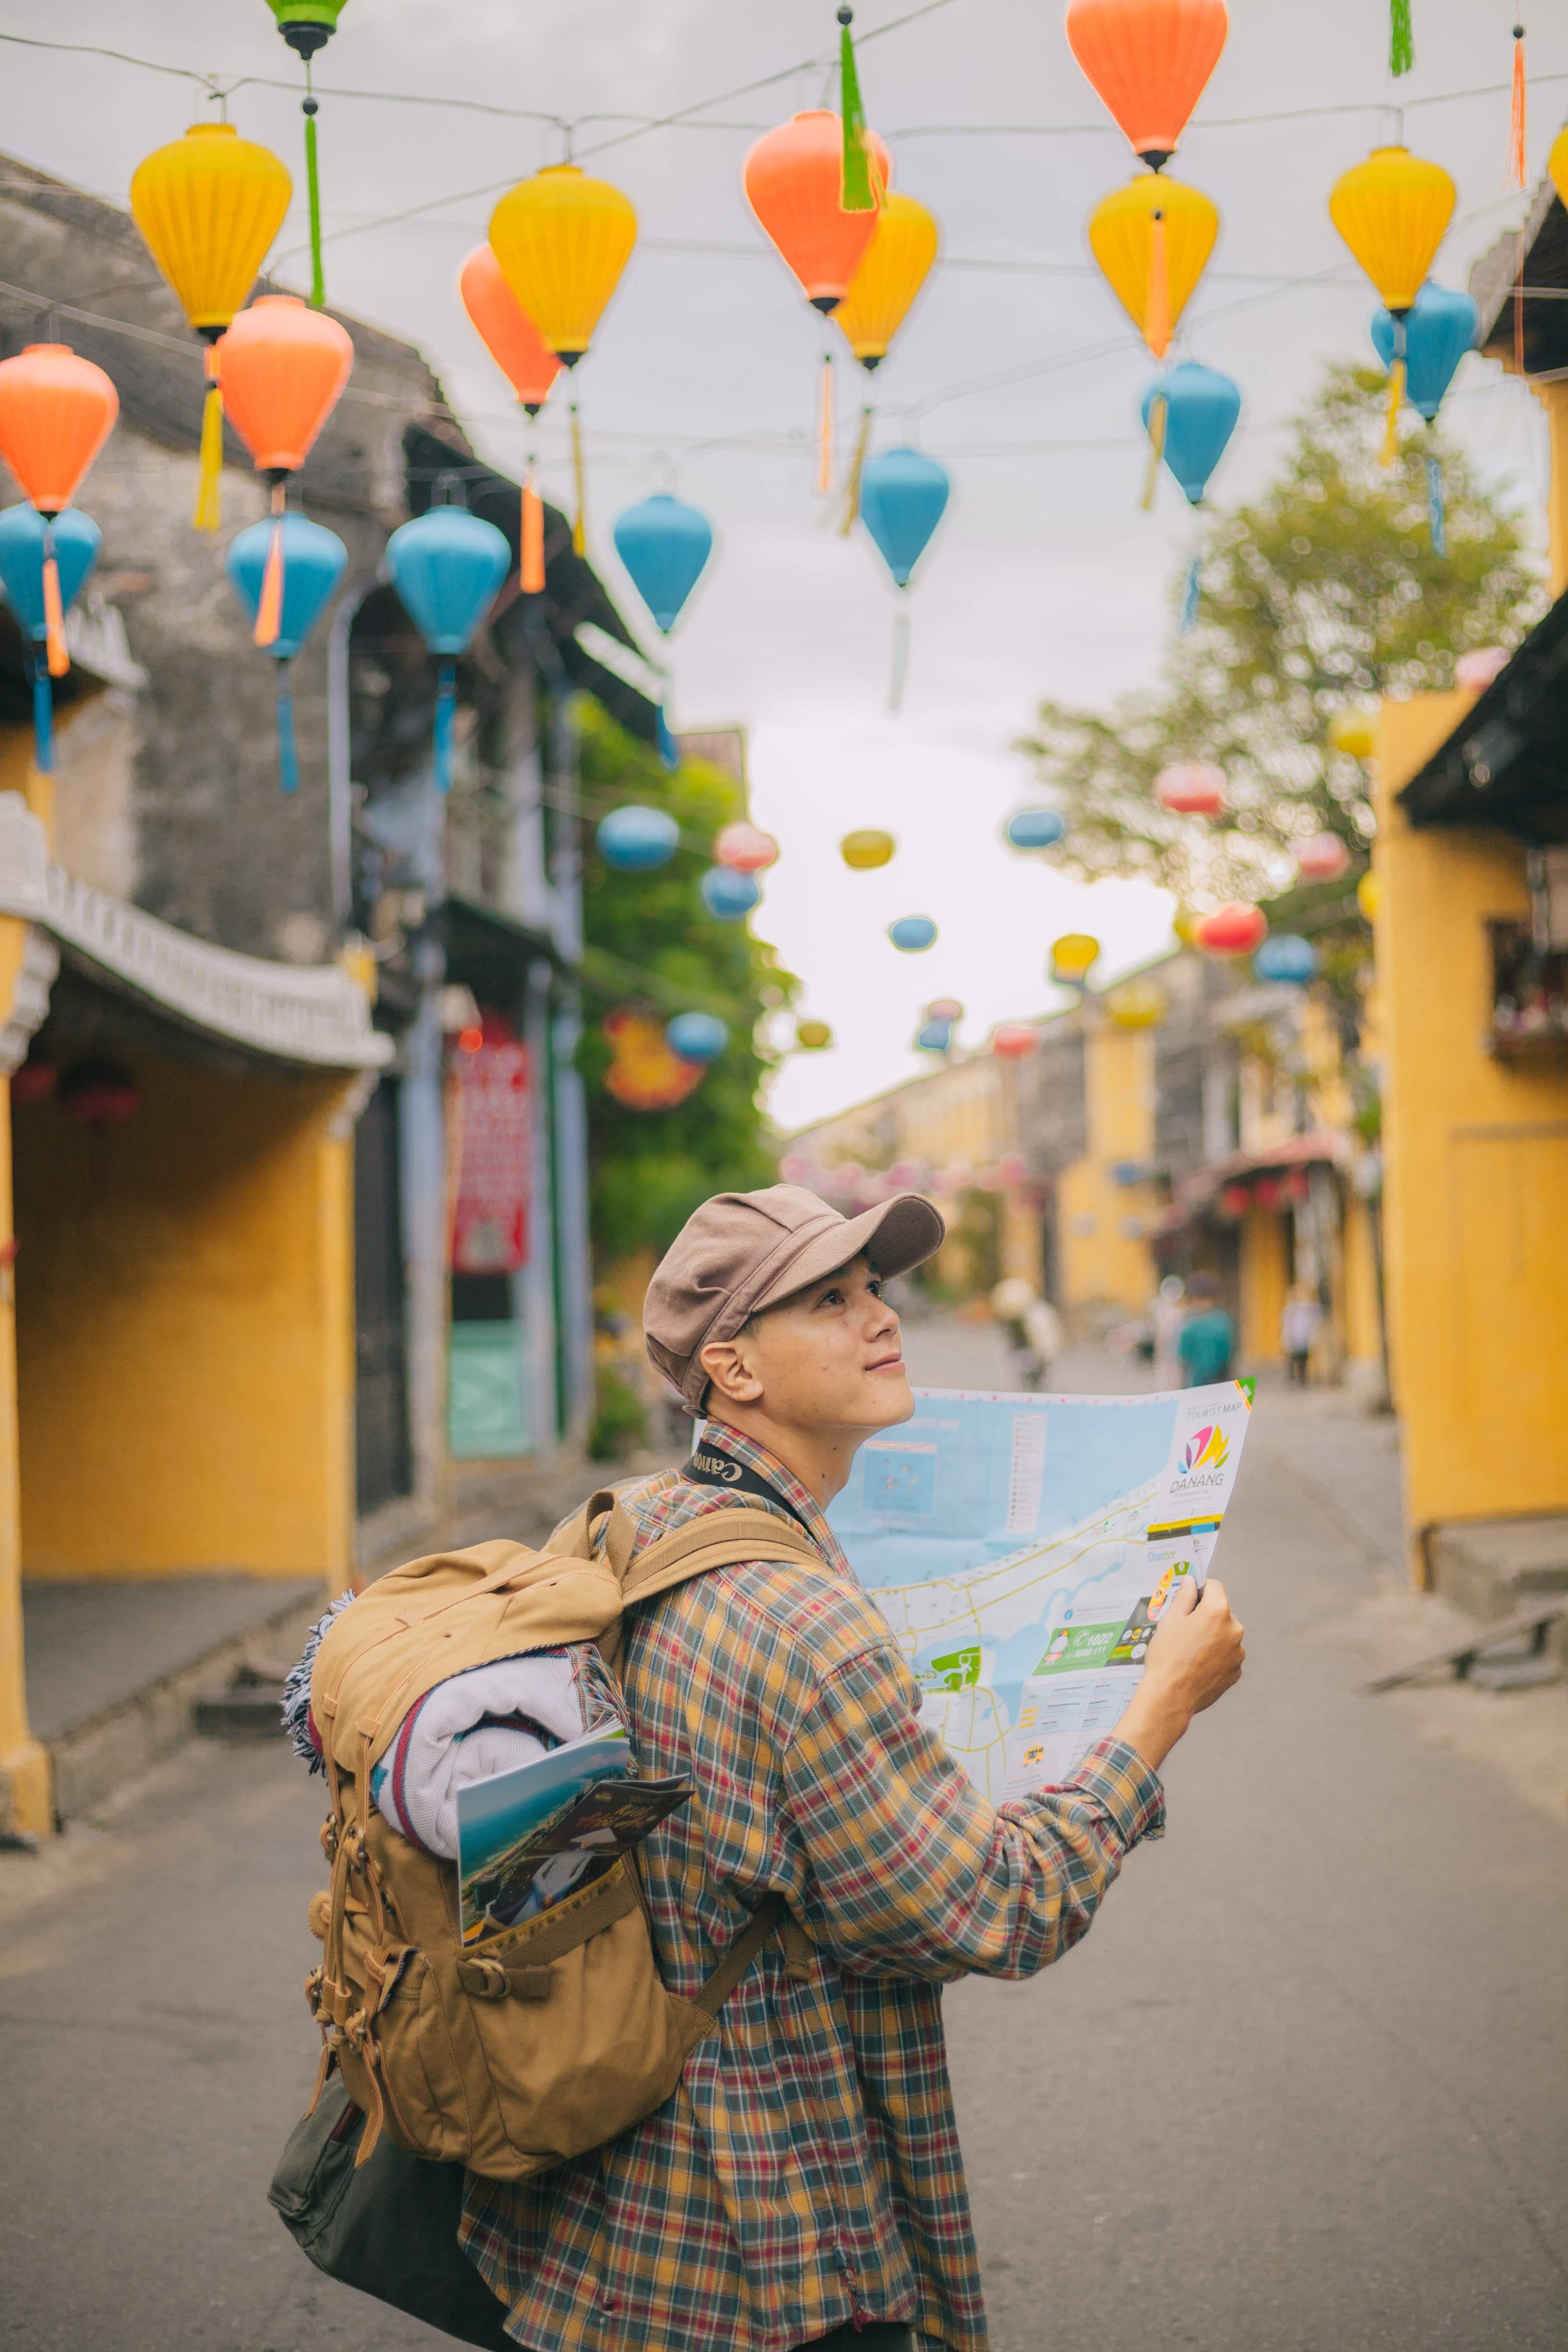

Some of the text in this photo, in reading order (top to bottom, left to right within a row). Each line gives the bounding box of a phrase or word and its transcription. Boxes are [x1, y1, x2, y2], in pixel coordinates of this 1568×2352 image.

[1187, 1406, 1222, 1420] TOURIST
[1222, 1402, 1242, 1414] MAP
[1170, 1473, 1223, 1493] DANANG
[1087, 1632, 1114, 1647] 1022
